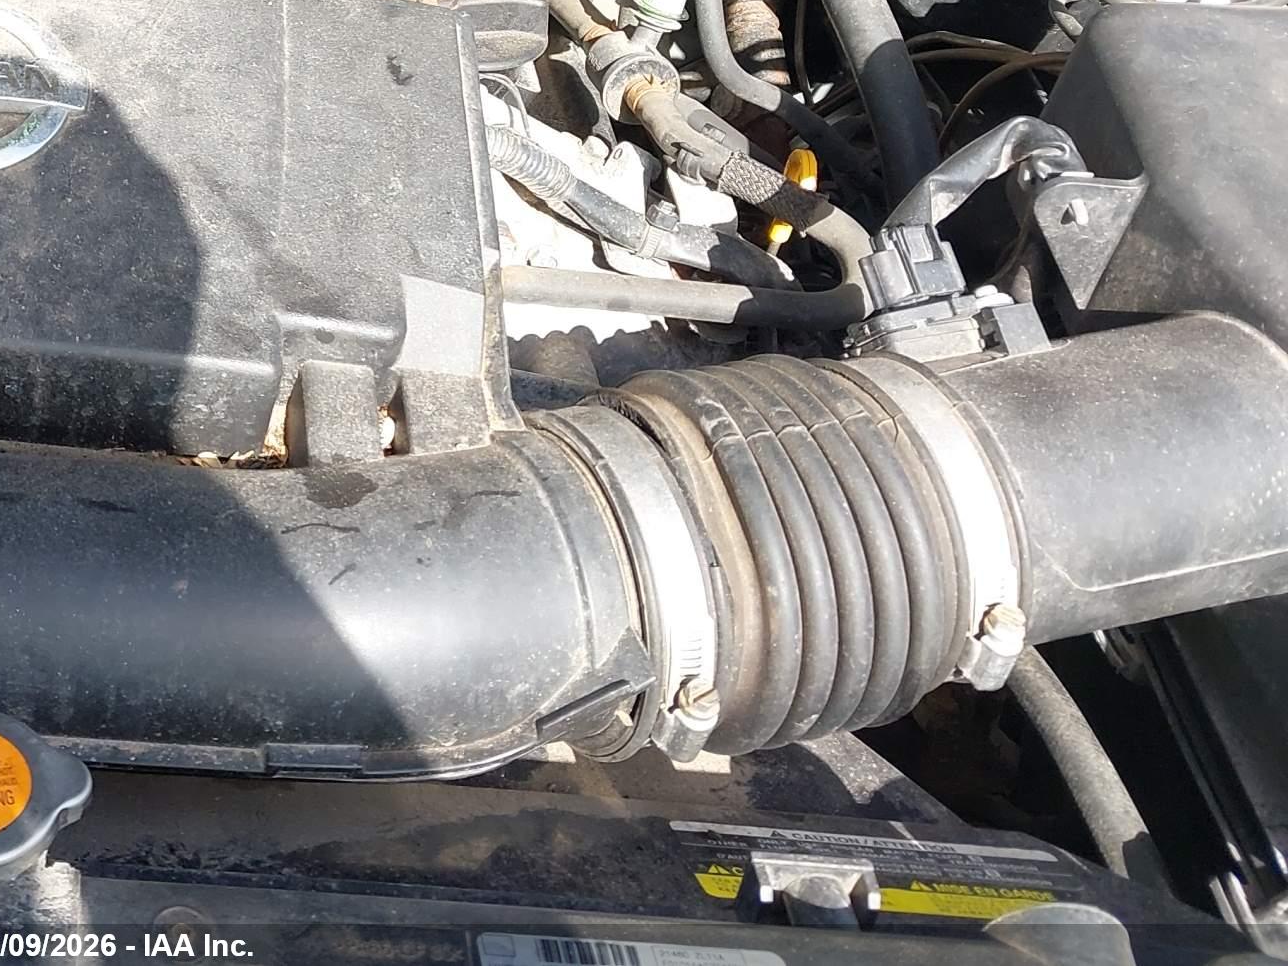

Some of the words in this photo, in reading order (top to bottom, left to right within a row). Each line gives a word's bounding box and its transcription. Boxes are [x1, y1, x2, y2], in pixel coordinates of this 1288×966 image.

[792, 833, 861, 845] CAUTION
[933, 881, 971, 895] MISE
[973, 885, 998, 897] EN
[999, 888, 1054, 902] GARDE
